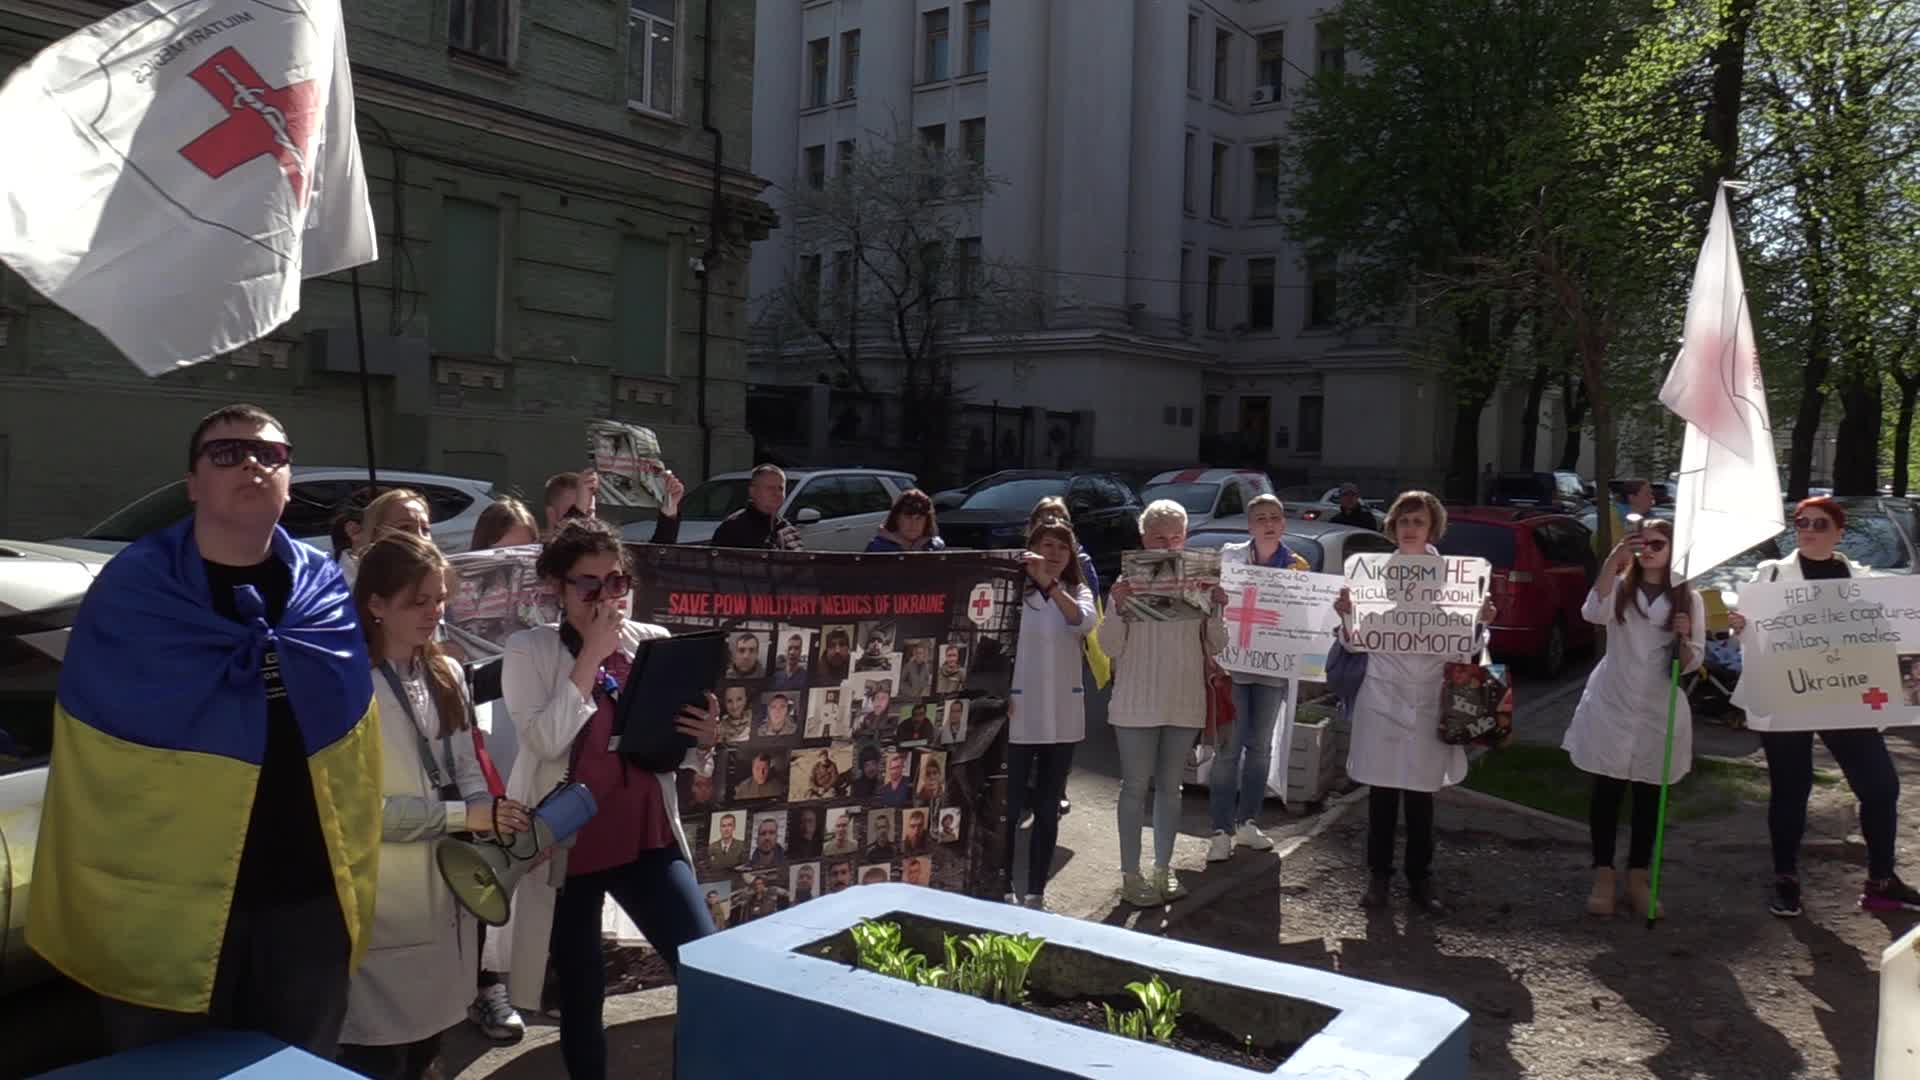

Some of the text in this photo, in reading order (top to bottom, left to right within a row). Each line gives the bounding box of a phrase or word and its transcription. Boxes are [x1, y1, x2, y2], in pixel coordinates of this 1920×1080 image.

[1350, 557, 1436, 591] Лікарям
[1444, 559, 1477, 584] НЕ
[670, 593, 946, 616] SAVE POW MILITARY MEDICS OF UKRAINE
[1404, 582, 1417, 602] в
[1784, 583, 1861, 605] HELP US
[1755, 611, 1817, 633] rescue
[1821, 607, 1847, 624] the
[1774, 627, 1901, 653] military medics
[1787, 667, 1868, 694] Ukraine
